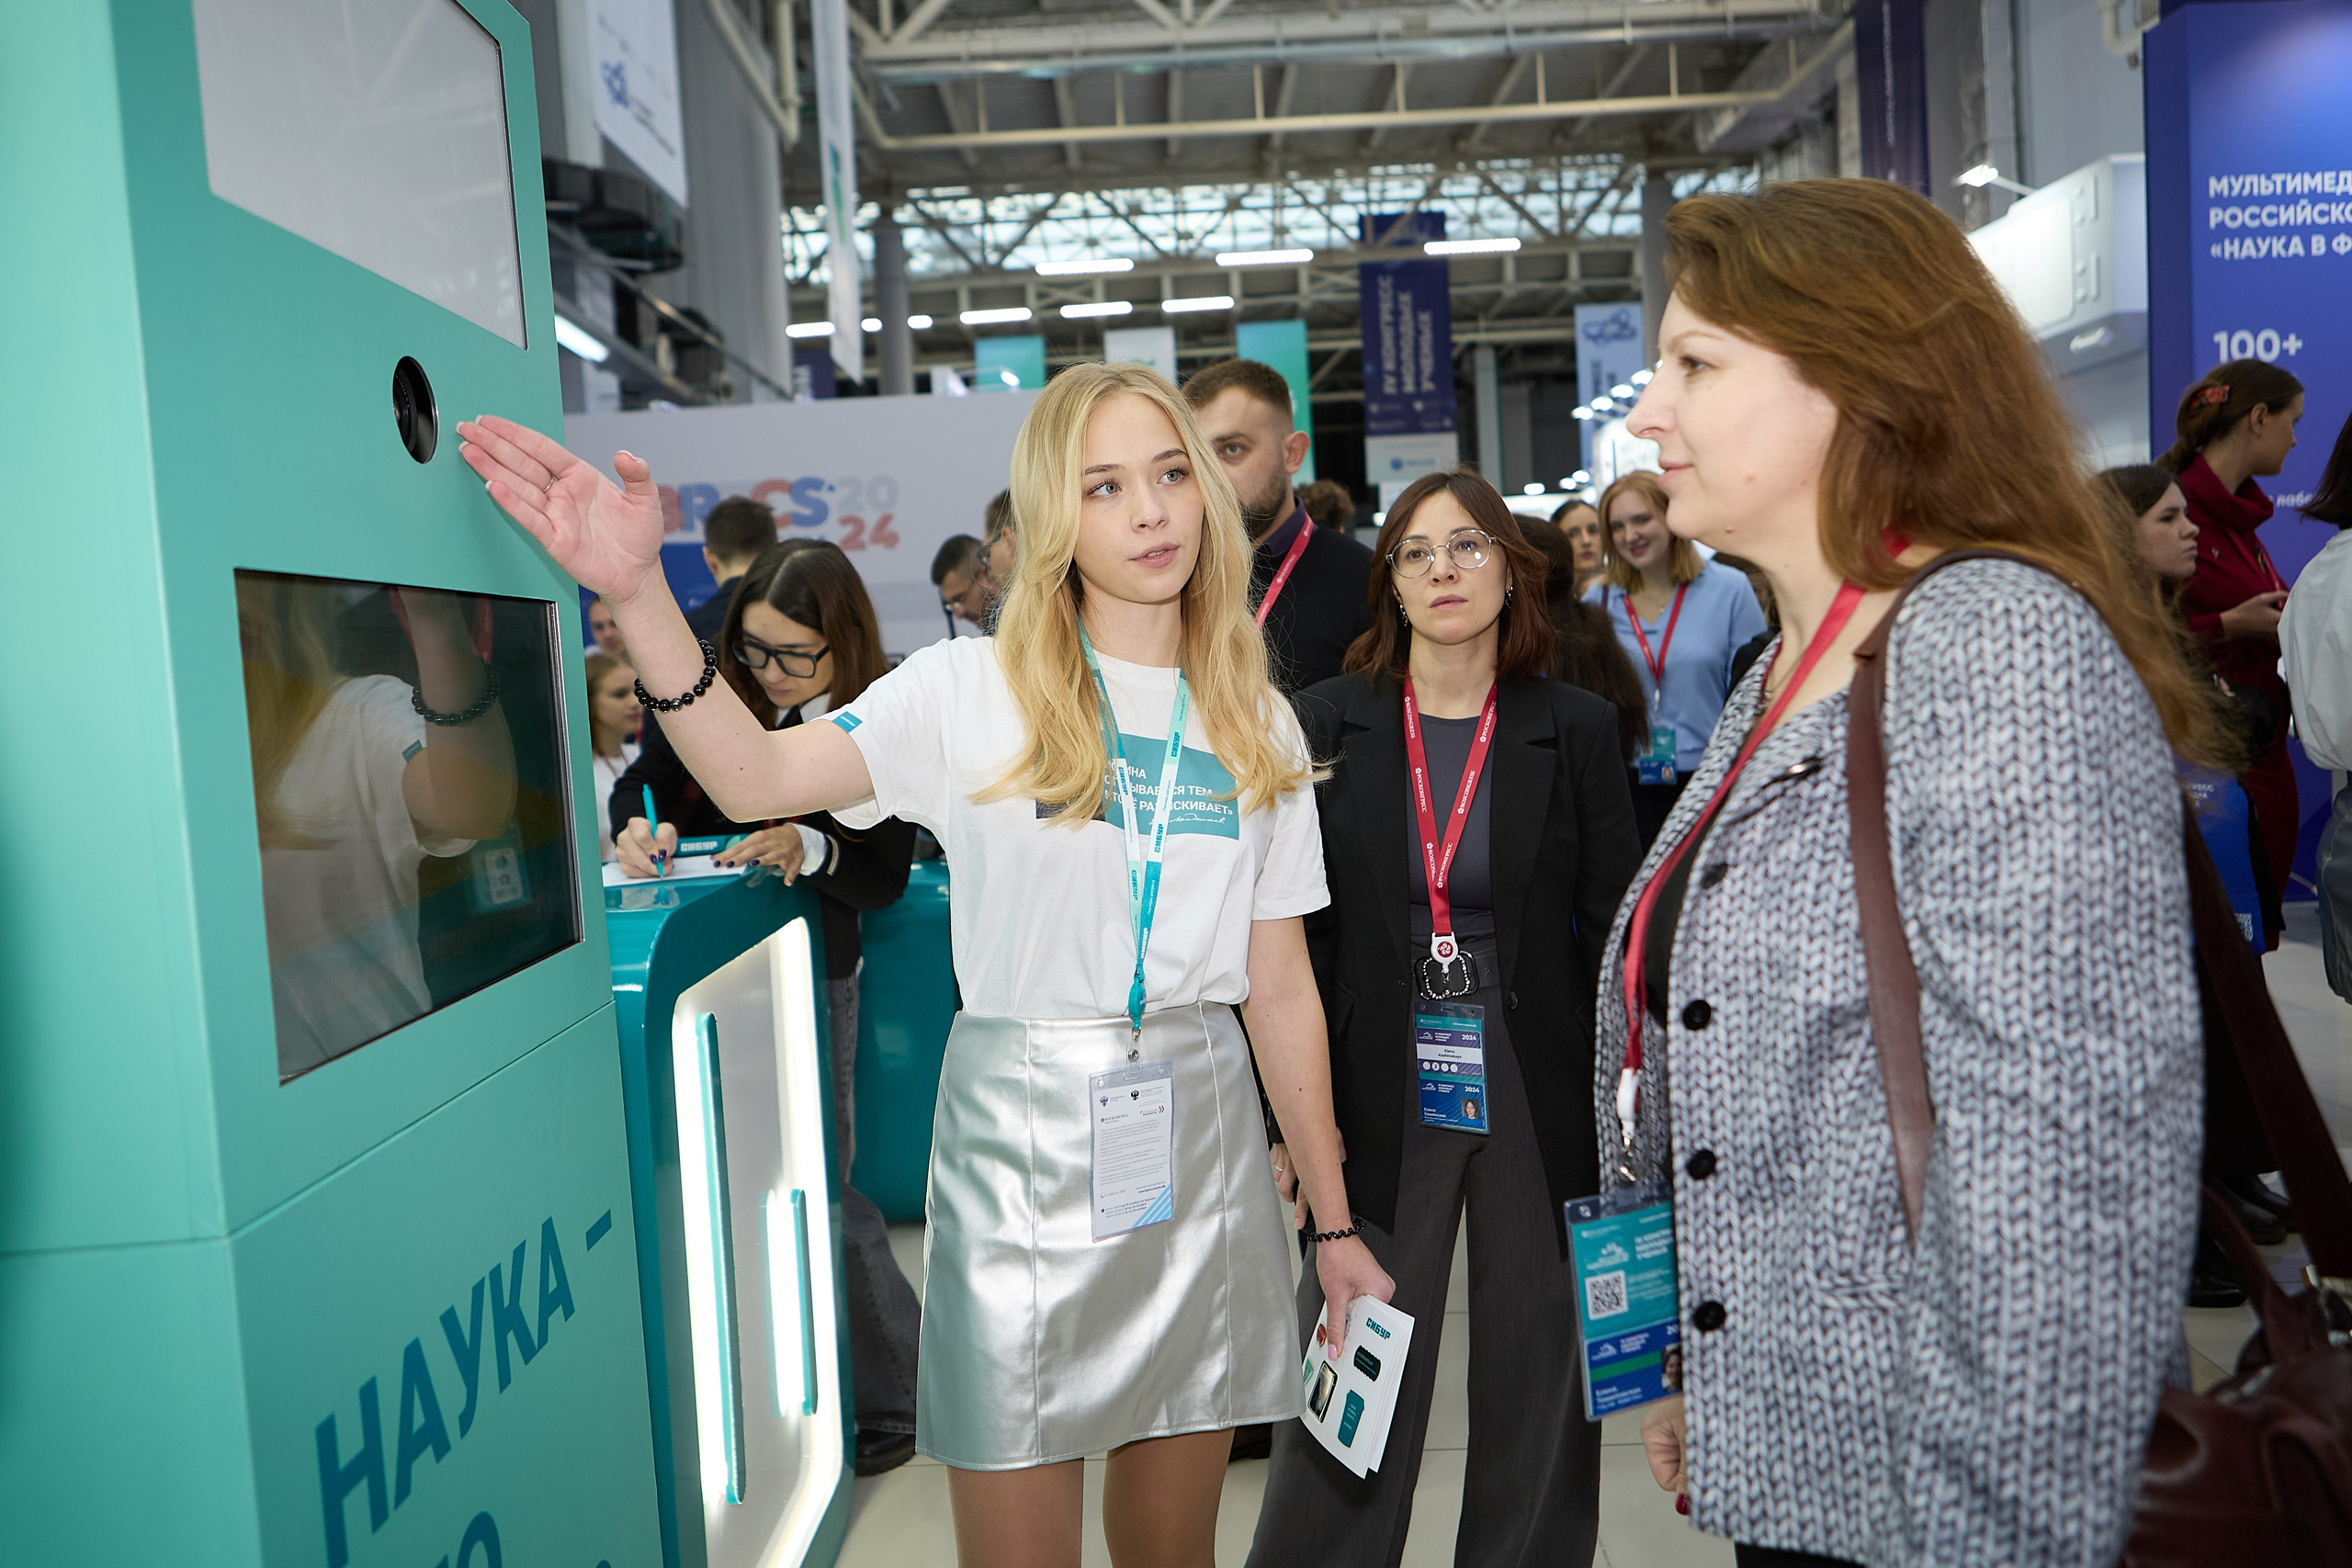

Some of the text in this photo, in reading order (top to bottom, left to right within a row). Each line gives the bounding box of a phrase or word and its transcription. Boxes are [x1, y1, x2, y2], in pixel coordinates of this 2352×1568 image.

[2211, 234, 2305, 261] «НАУКА
[2311, 233, 2326, 256] В
[2213, 328, 2303, 365] 100+
[838, 513, 900, 551] 24
[1406, 702, 1415, 739] ROSCONGRESS
[1170, 731, 1180, 758] СИБУР
[1417, 773, 1427, 812] РОСКОНГРЕСС
[1460, 771, 1476, 808] ROSCONGRESS
[680, 840, 718, 852] СИБУР
[1154, 823, 1165, 853] СИБУР
[1439, 842, 1453, 882] РОСКОНГРЕСС
[1365, 1317, 1391, 1340] СИБУР
[315, 1216, 575, 1568] НАУКА
